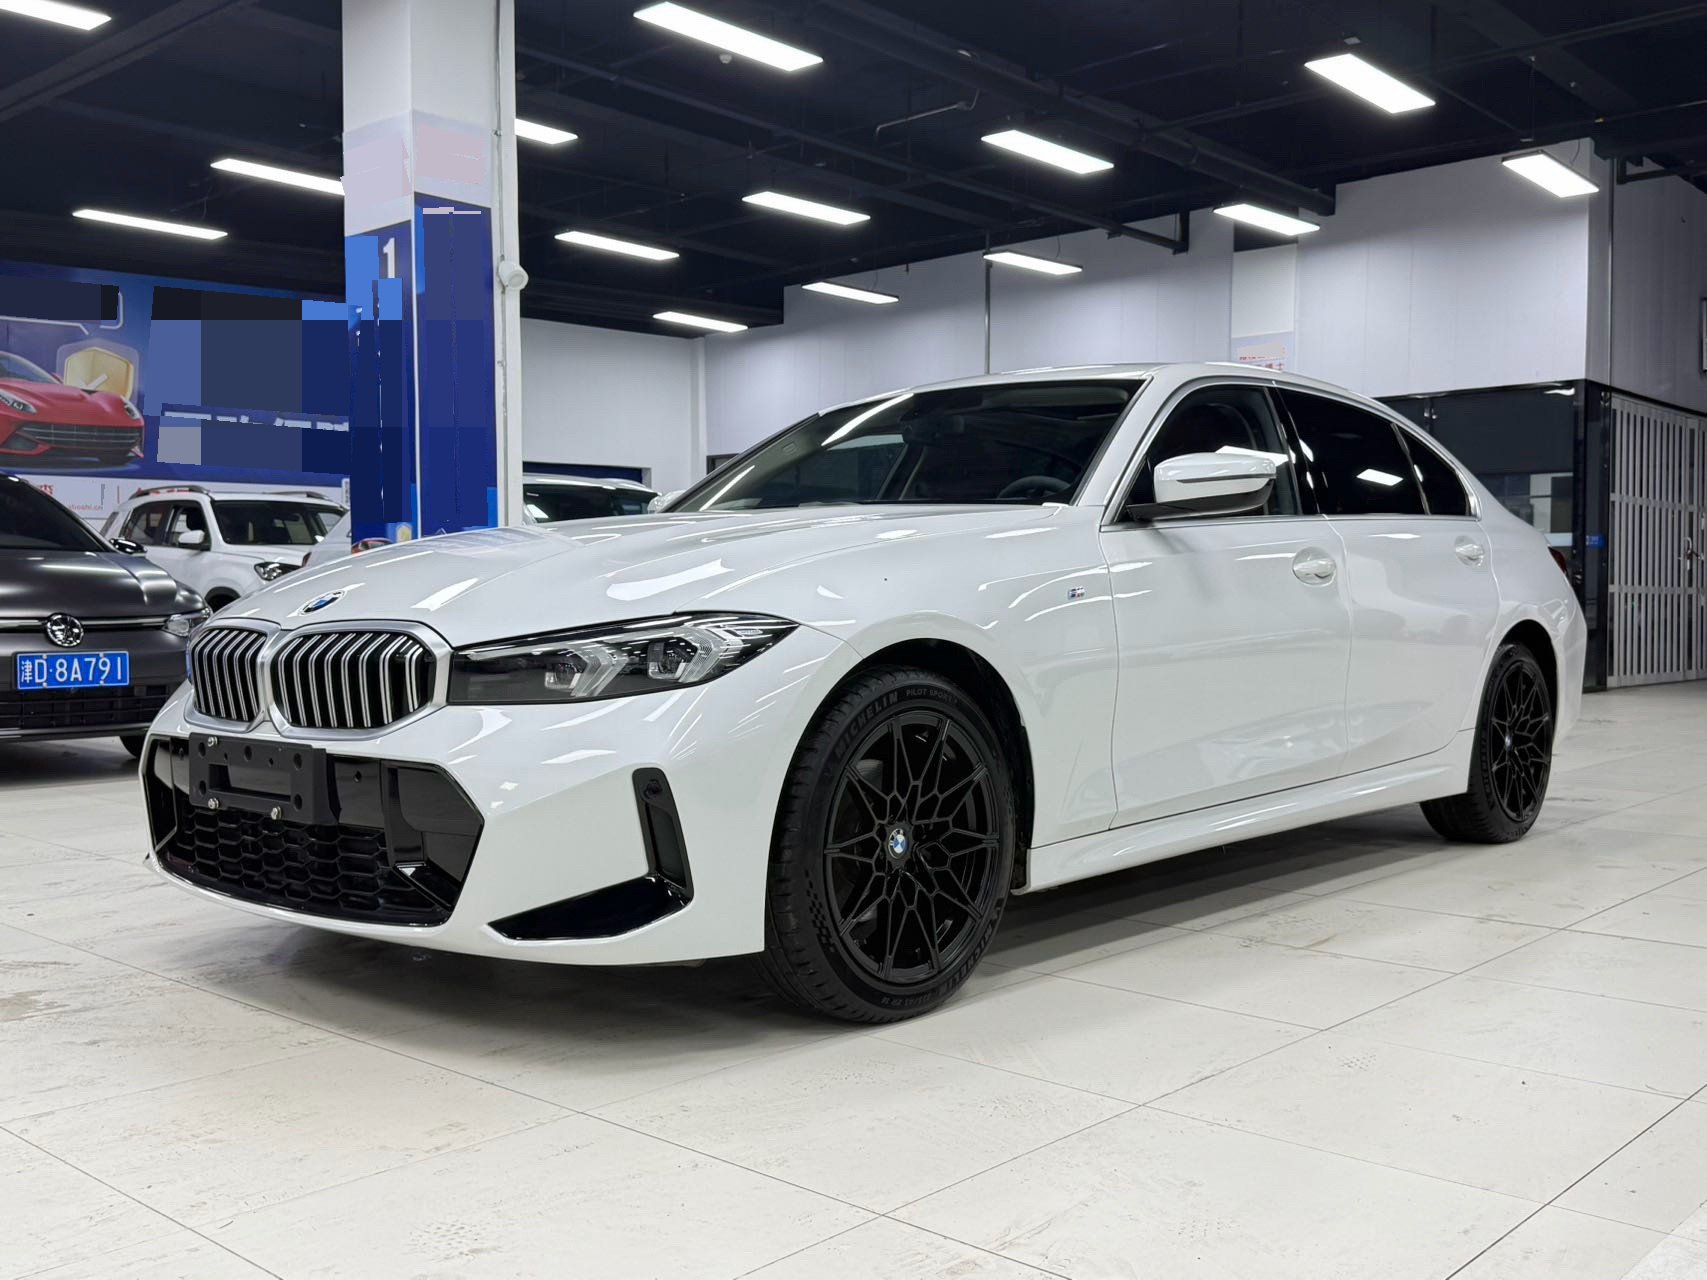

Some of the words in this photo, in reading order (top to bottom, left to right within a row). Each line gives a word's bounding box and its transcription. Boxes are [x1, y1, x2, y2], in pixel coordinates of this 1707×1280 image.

[383, 237, 395, 279] 1
[834, 691, 899, 759] MICHELIN
[906, 688, 928, 697] PILOT
